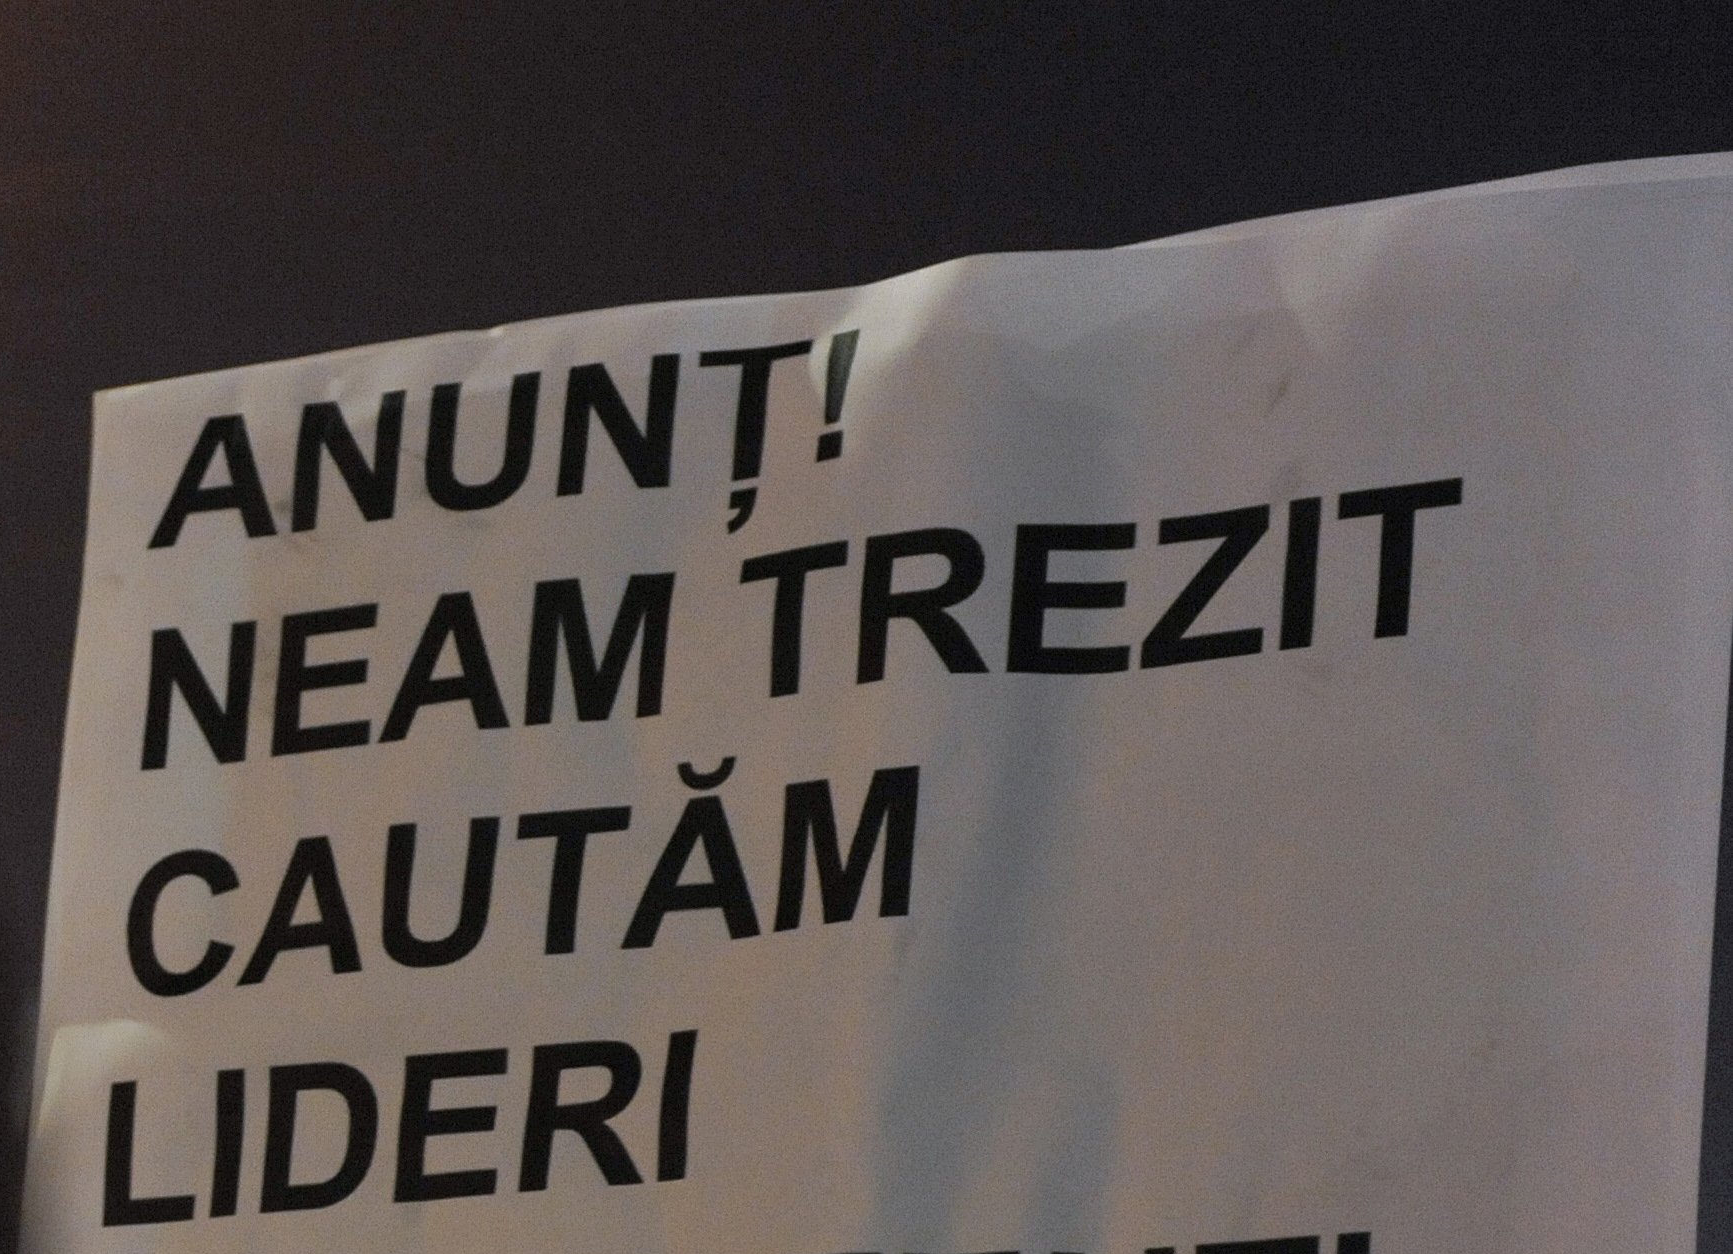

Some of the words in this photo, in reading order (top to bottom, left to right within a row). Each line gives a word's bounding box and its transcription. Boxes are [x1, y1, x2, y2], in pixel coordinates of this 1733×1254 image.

[145, 327, 861, 551] ANUNȚ!
[138, 569, 679, 773] NEAM
[736, 474, 1467, 700] TREZIT
[124, 753, 923, 999] CAUTĂM
[100, 1026, 701, 1229] LIDERI
